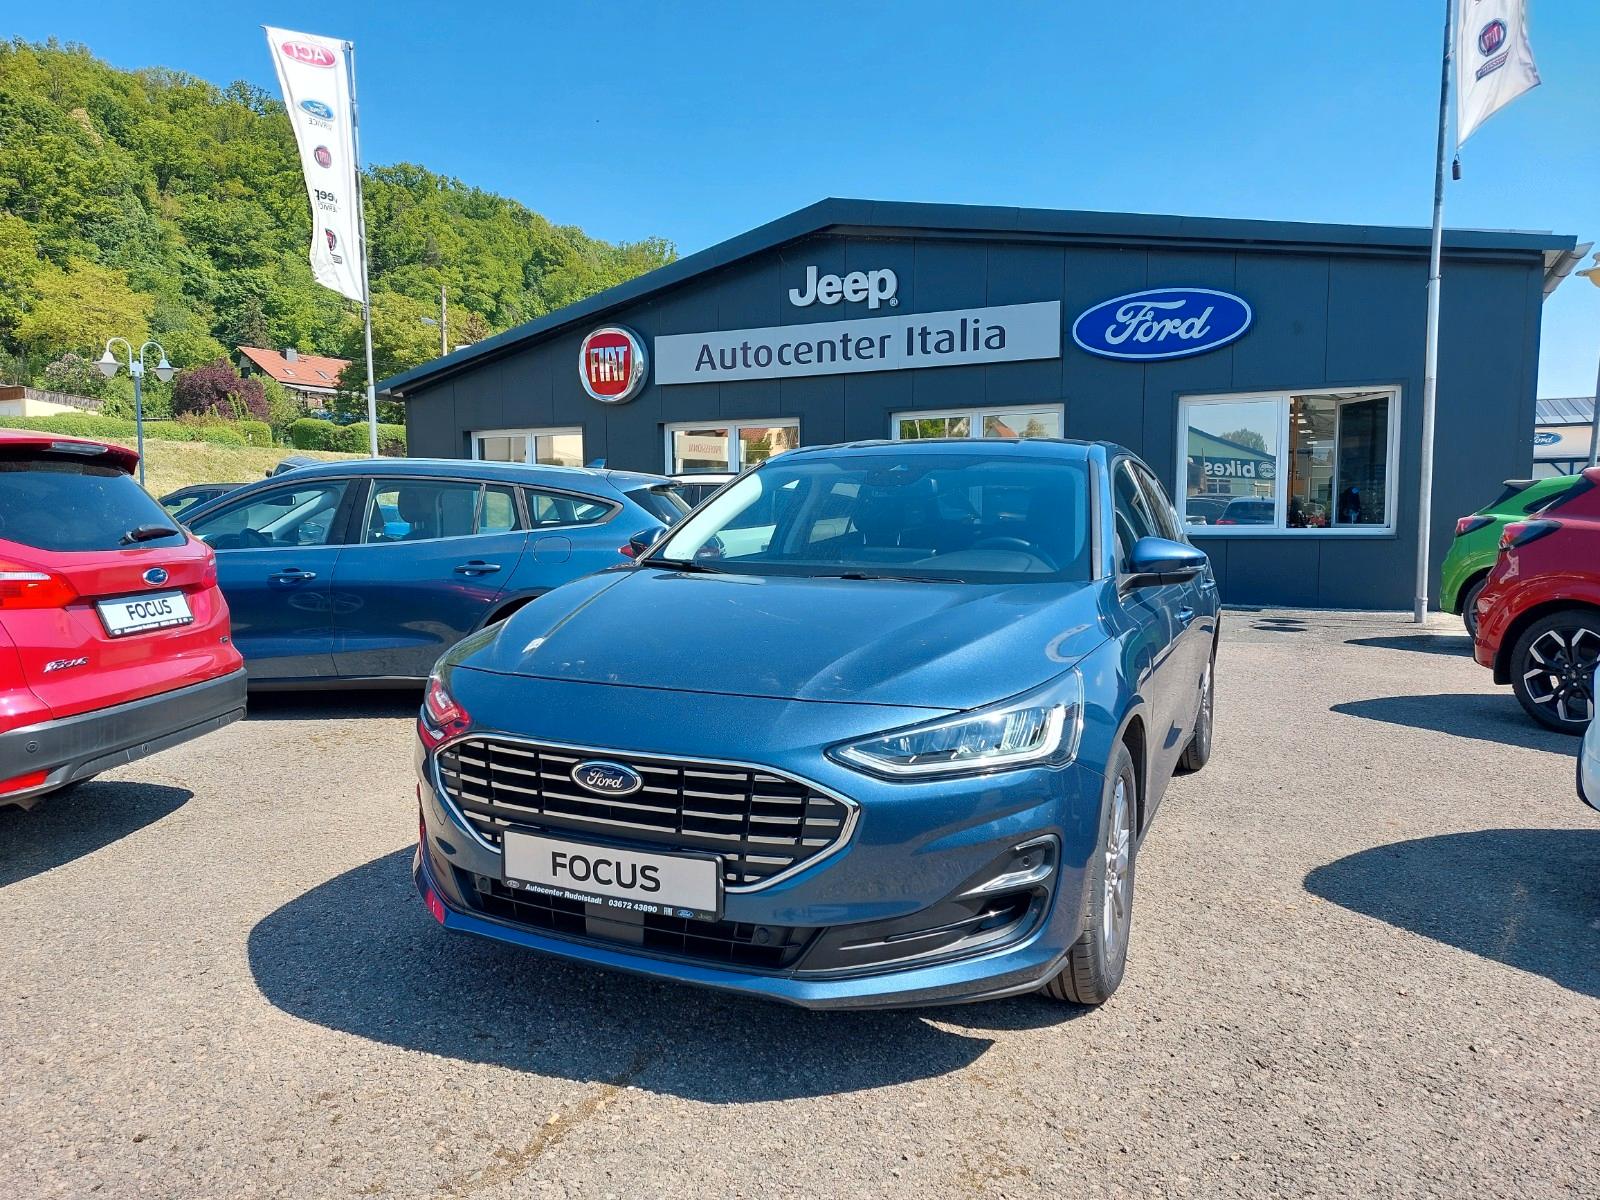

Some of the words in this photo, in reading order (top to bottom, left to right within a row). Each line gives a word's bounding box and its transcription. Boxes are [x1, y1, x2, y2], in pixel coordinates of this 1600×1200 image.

[789, 265, 897, 309] Jeep
[1105, 299, 1215, 345] Ford
[590, 346, 628, 383] FIAT
[694, 333, 892, 372] Autocenter
[906, 318, 1006, 357] Italia
[125, 599, 173, 620] FOCUS
[586, 768, 624, 789] Ford
[551, 851, 661, 893] FOCUS
[525, 883, 563, 897] Autocenter
[564, 890, 602, 905] Rudolstadt
[608, 899, 632, 910] 03672
[633, 903, 658, 913] 43890
